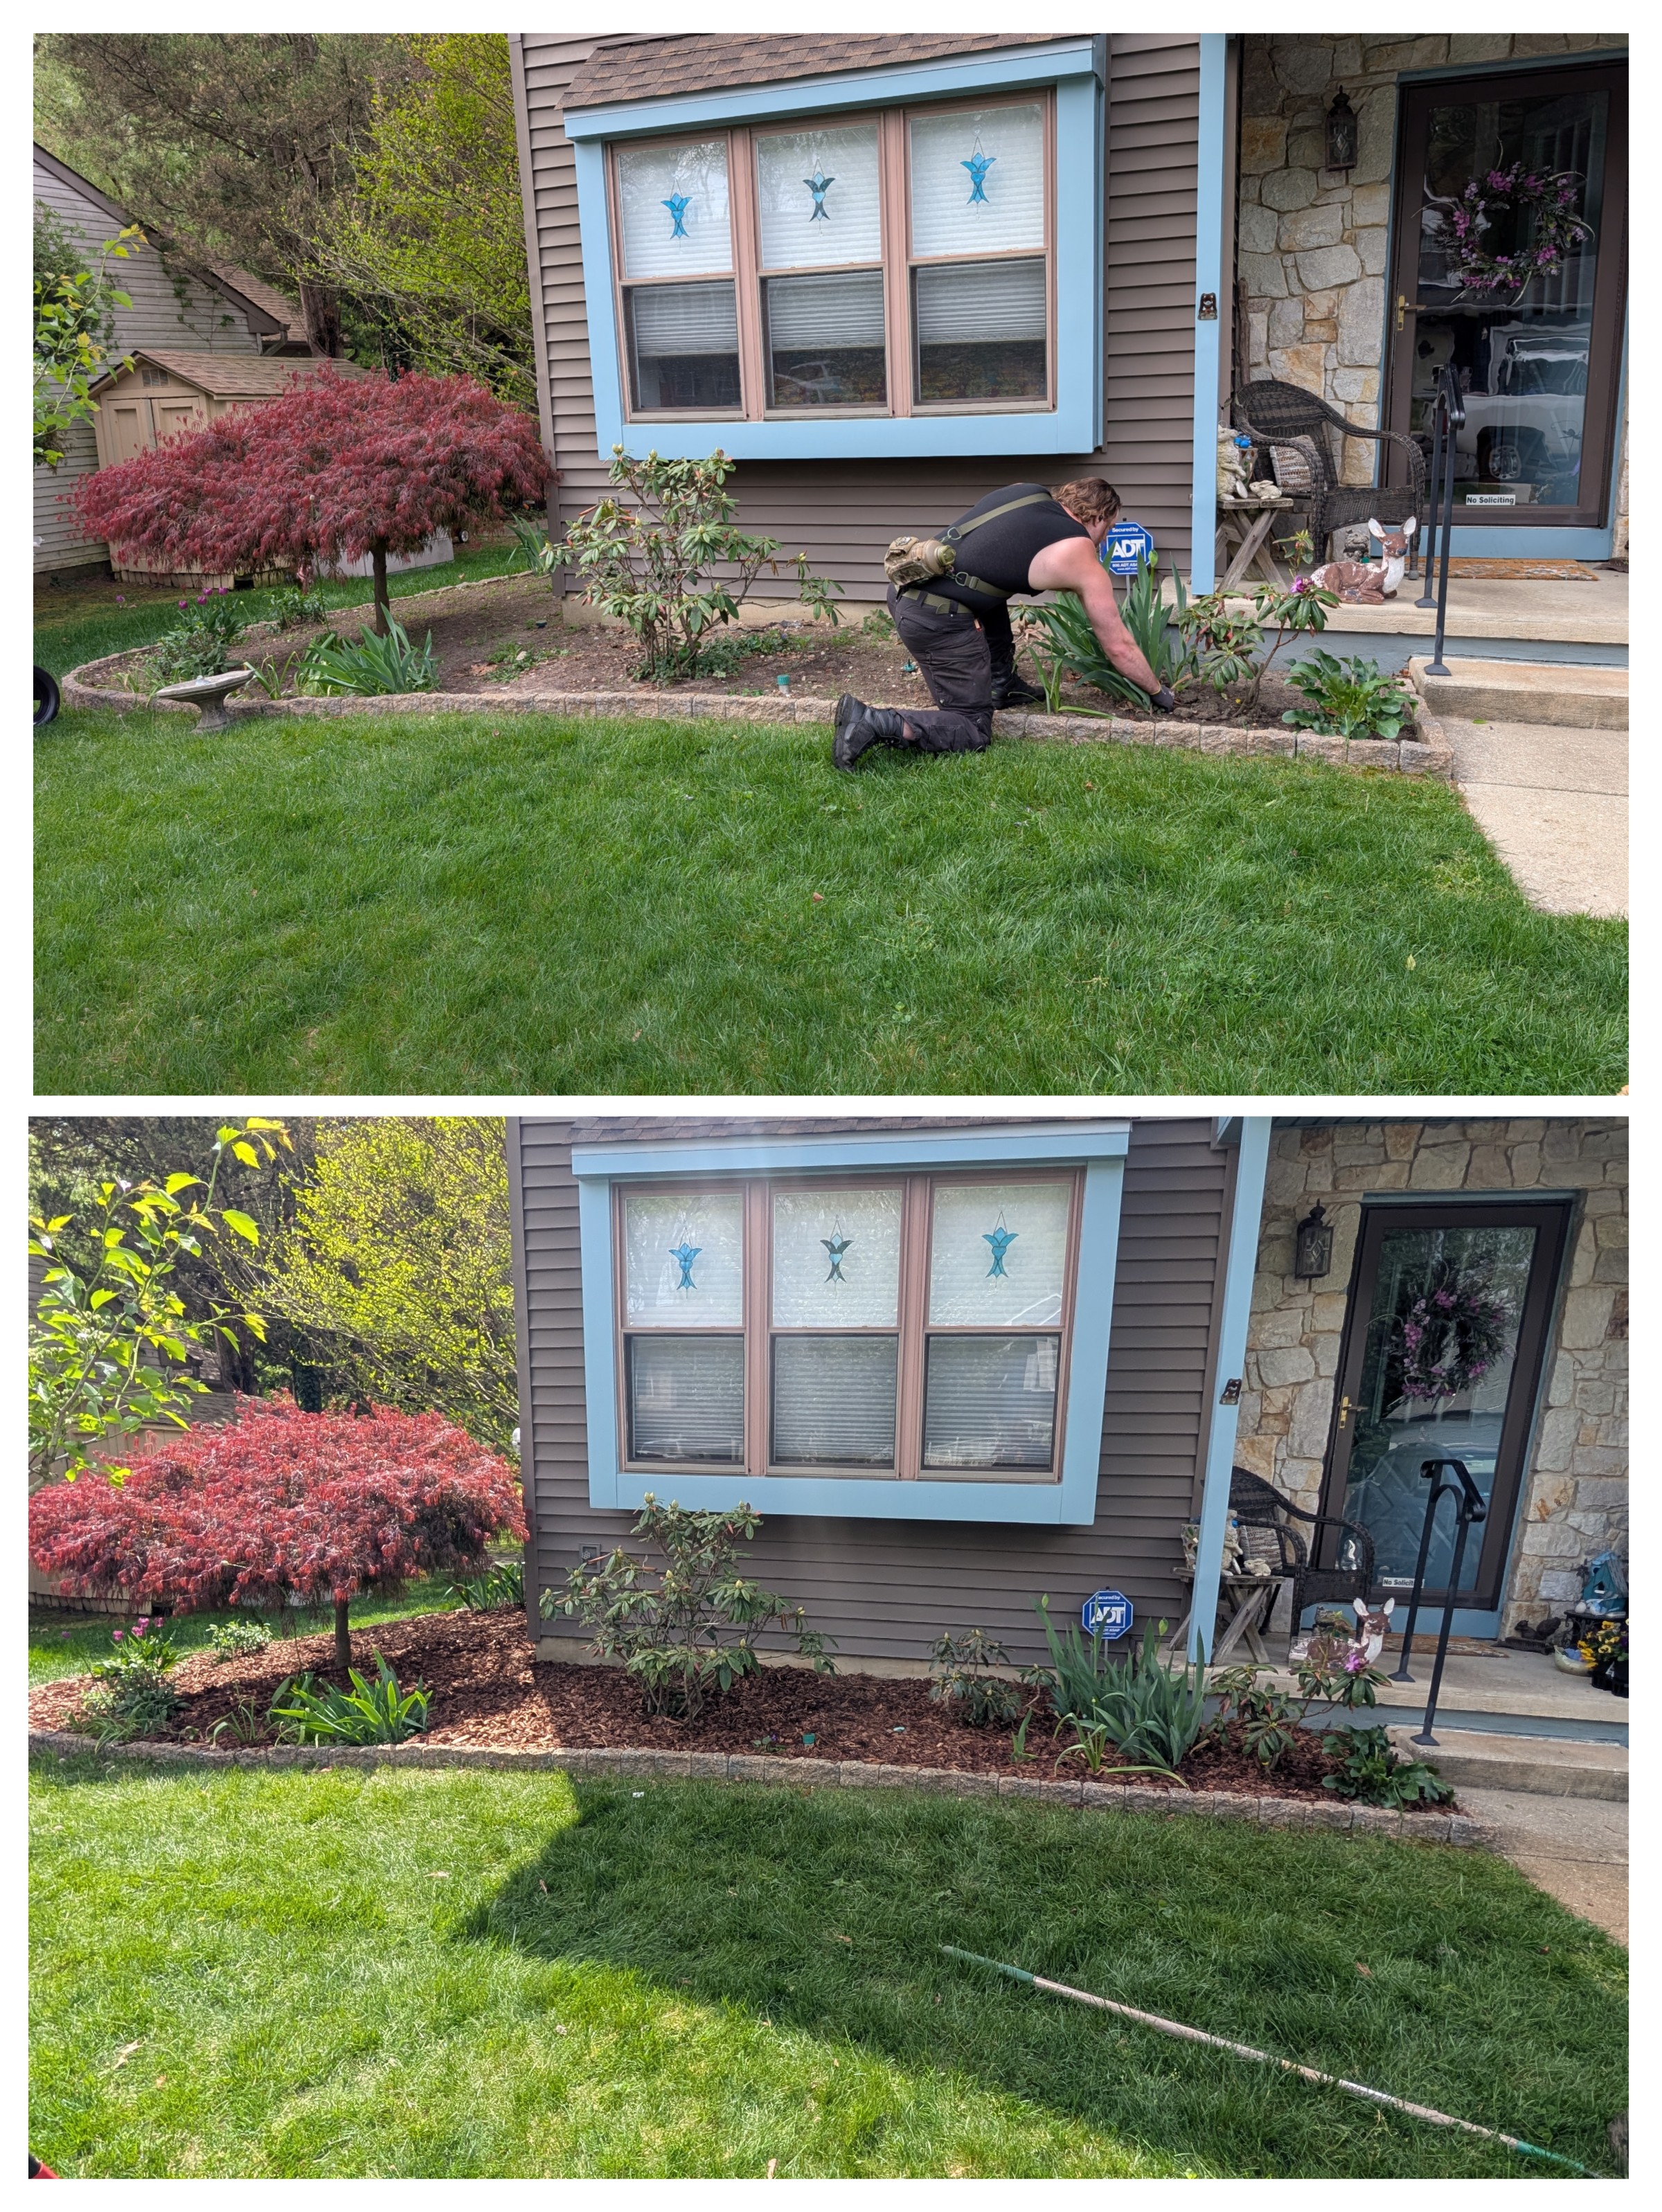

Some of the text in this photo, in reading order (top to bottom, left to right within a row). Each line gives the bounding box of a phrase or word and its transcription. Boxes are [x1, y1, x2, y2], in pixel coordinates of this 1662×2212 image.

[1479, 496, 1514, 505] Soliciting
[1111, 539, 1144, 558] ADT
[1091, 1606, 1125, 1624] ADT
